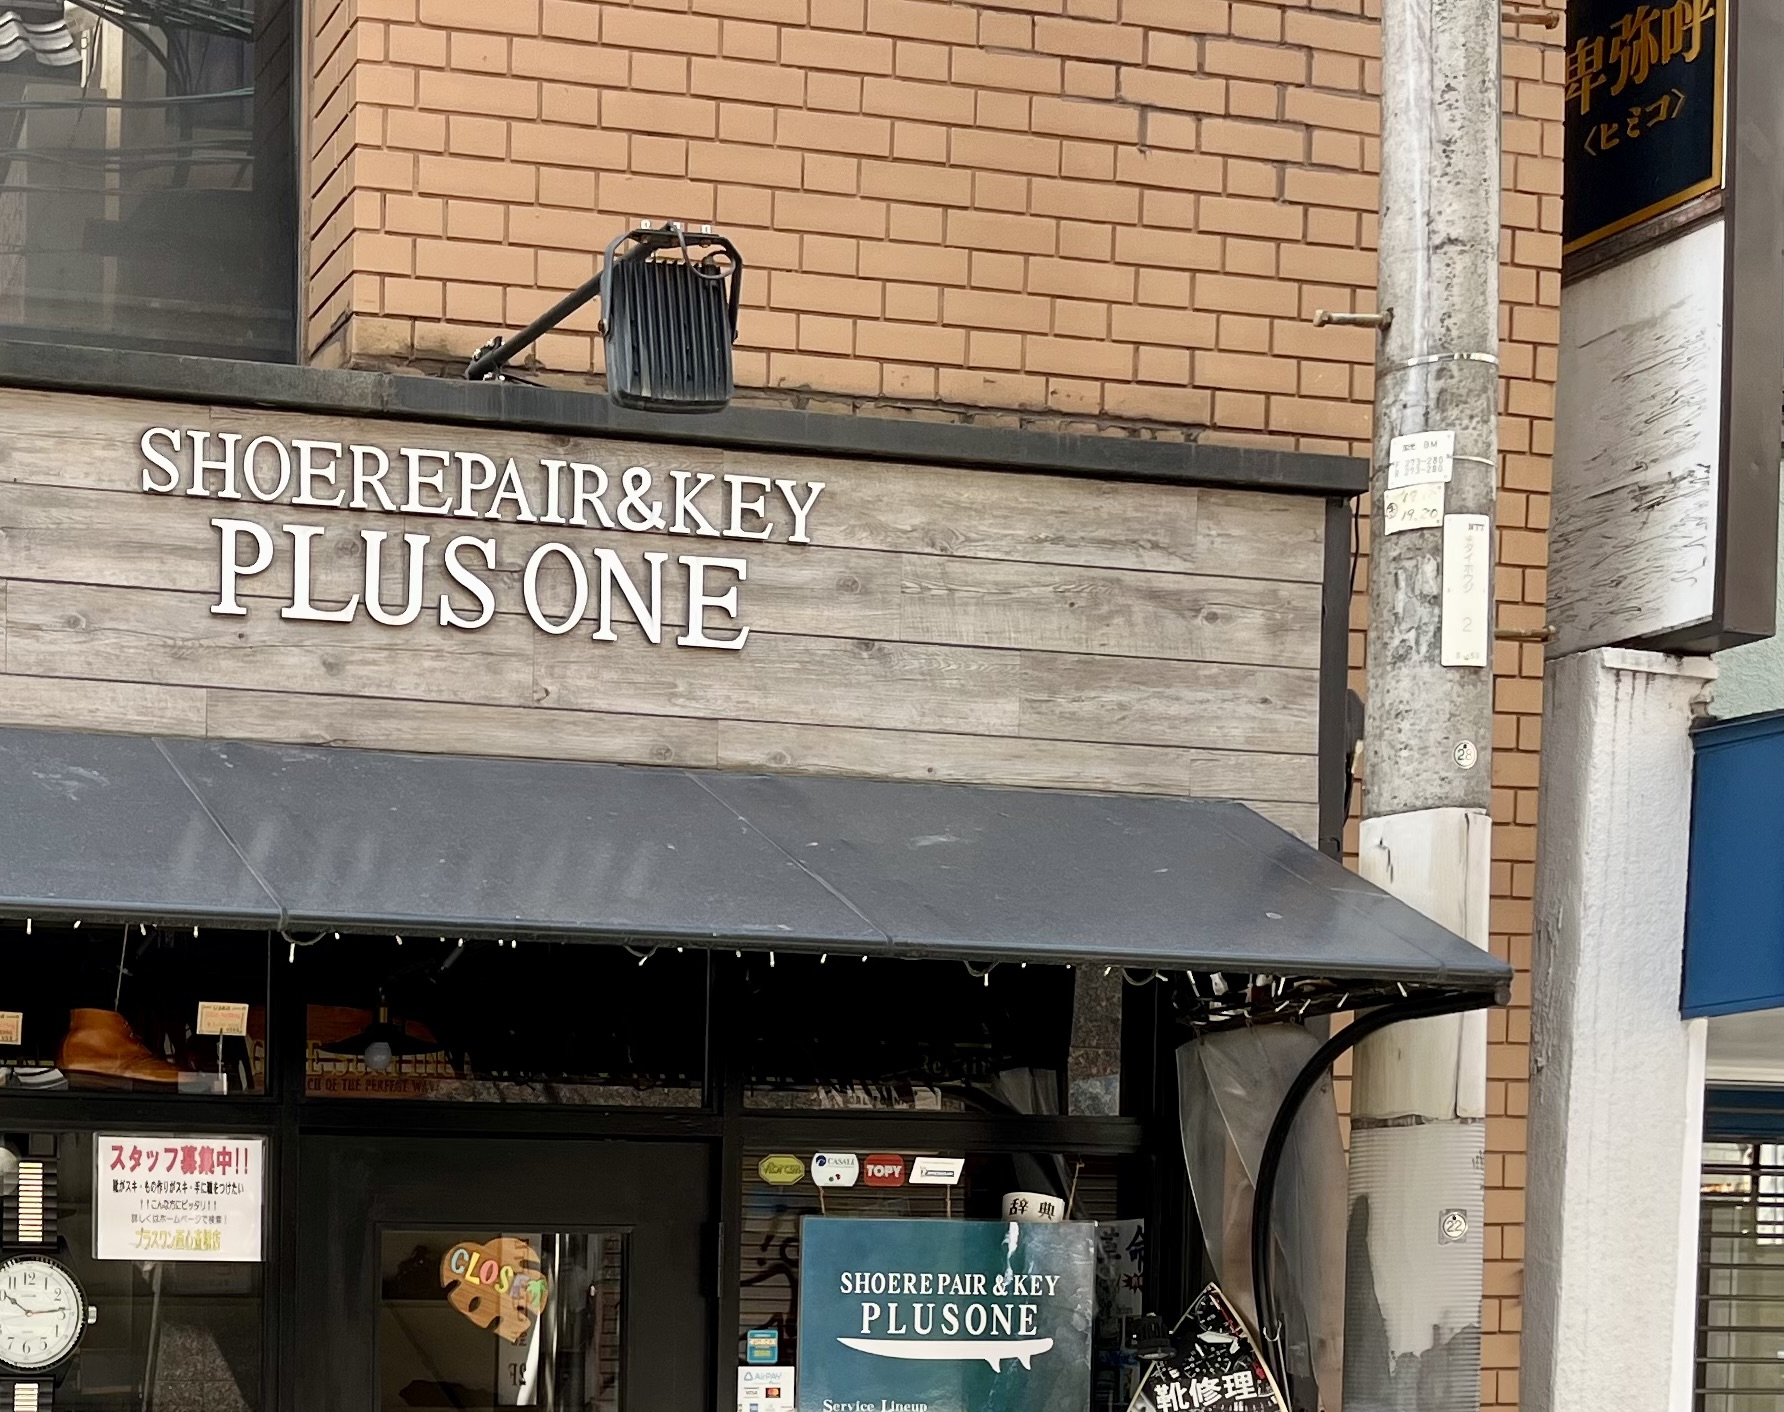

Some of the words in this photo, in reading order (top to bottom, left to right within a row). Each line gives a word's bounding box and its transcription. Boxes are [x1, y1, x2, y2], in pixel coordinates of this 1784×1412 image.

[140, 425, 825, 545] SHOEREPAIR&KEY
[210, 516, 501, 631] PLUS
[523, 541, 750, 650] ONE
[866, 1164, 903, 1178] TOPY
[23, 1271, 36, 1286] 12
[53, 1288, 62, 1301] 2
[860, 1302, 1038, 1337] PLUSONE
[7, 1336, 15, 1350] 7
[22, 1340, 31, 1354] 6
